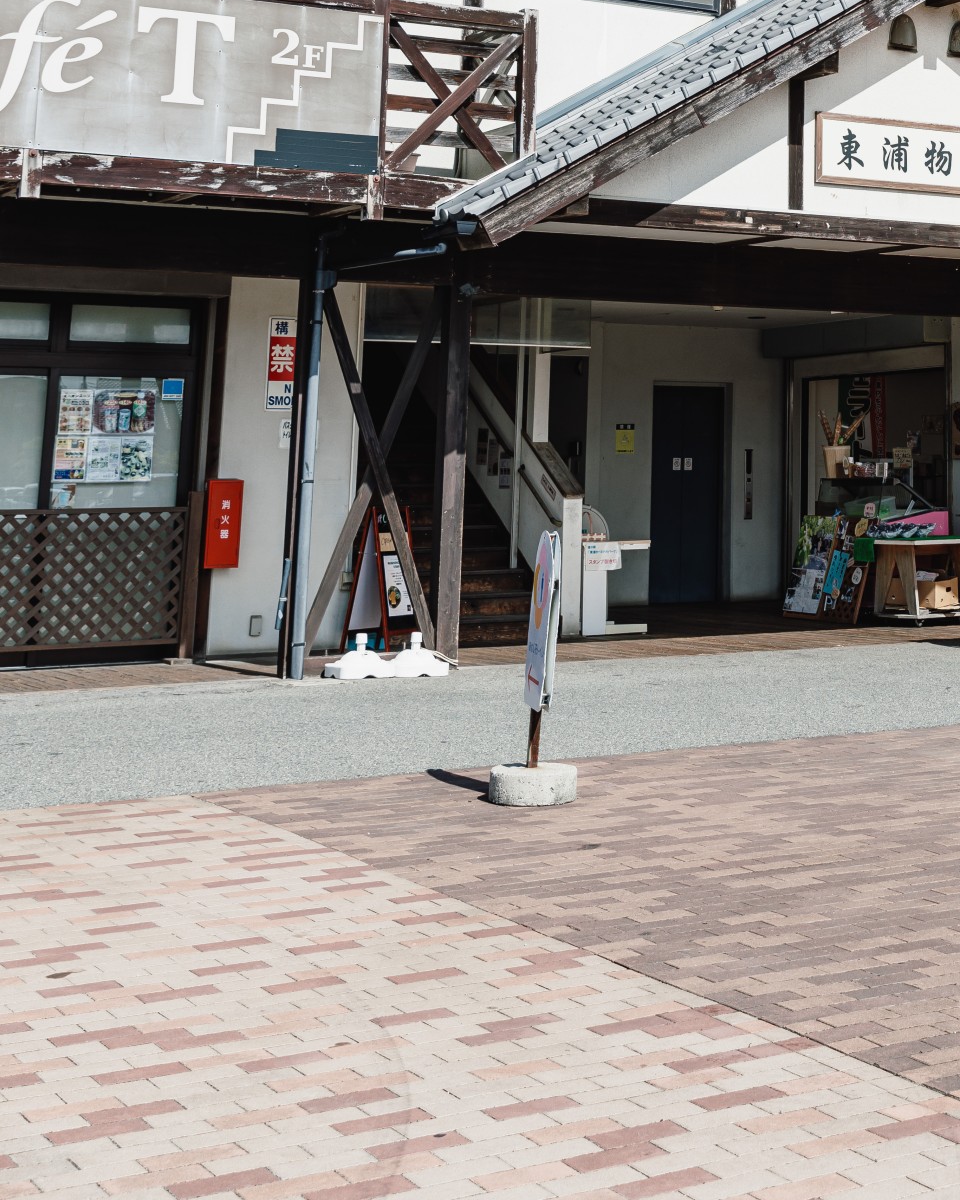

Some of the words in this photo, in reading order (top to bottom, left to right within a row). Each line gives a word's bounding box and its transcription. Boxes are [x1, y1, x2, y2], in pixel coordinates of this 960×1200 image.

[137, 6, 236, 106] T
[271, 28, 326, 70] 2F
[271, 343, 294, 373] 禁
[268, 396, 293, 406] SMO
[219, 500, 231, 539] 消火器
